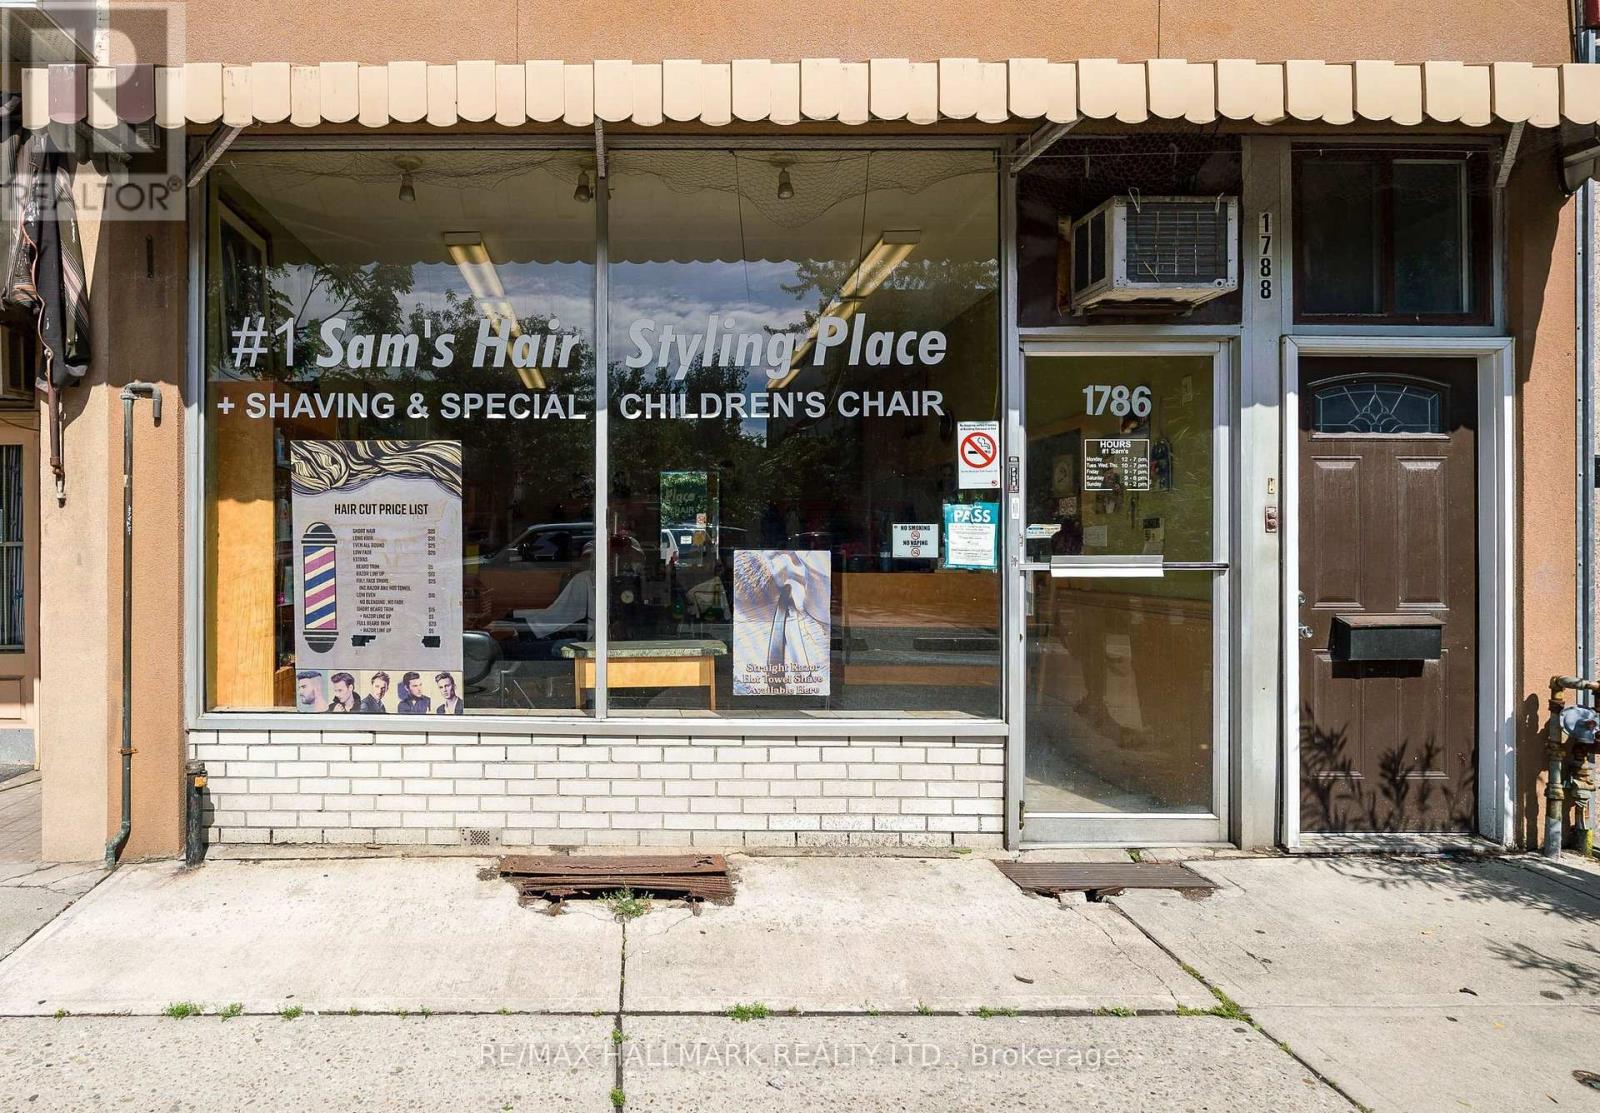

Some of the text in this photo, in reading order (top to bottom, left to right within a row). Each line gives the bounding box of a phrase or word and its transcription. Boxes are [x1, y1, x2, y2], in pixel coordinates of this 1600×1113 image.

[1260, 213, 1272, 299] 1788
[231, 313, 947, 380] #1 Sam's Hair Styling Place
[245, 392, 395, 419] SHAVING
[406, 392, 429, 420] &
[440, 392, 587, 420] SPECIAL
[620, 391, 826, 420] CHILDREN'S
[837, 390, 945, 419] CHAIR
[1082, 384, 1152, 417] 1786
[334, 504, 429, 515] HAIR CUT PRICE LIST
[954, 510, 991, 523] PASS
[746, 663, 788, 674] Straight
[762, 674, 792, 683] Towel
[794, 674, 822, 684] Shave
